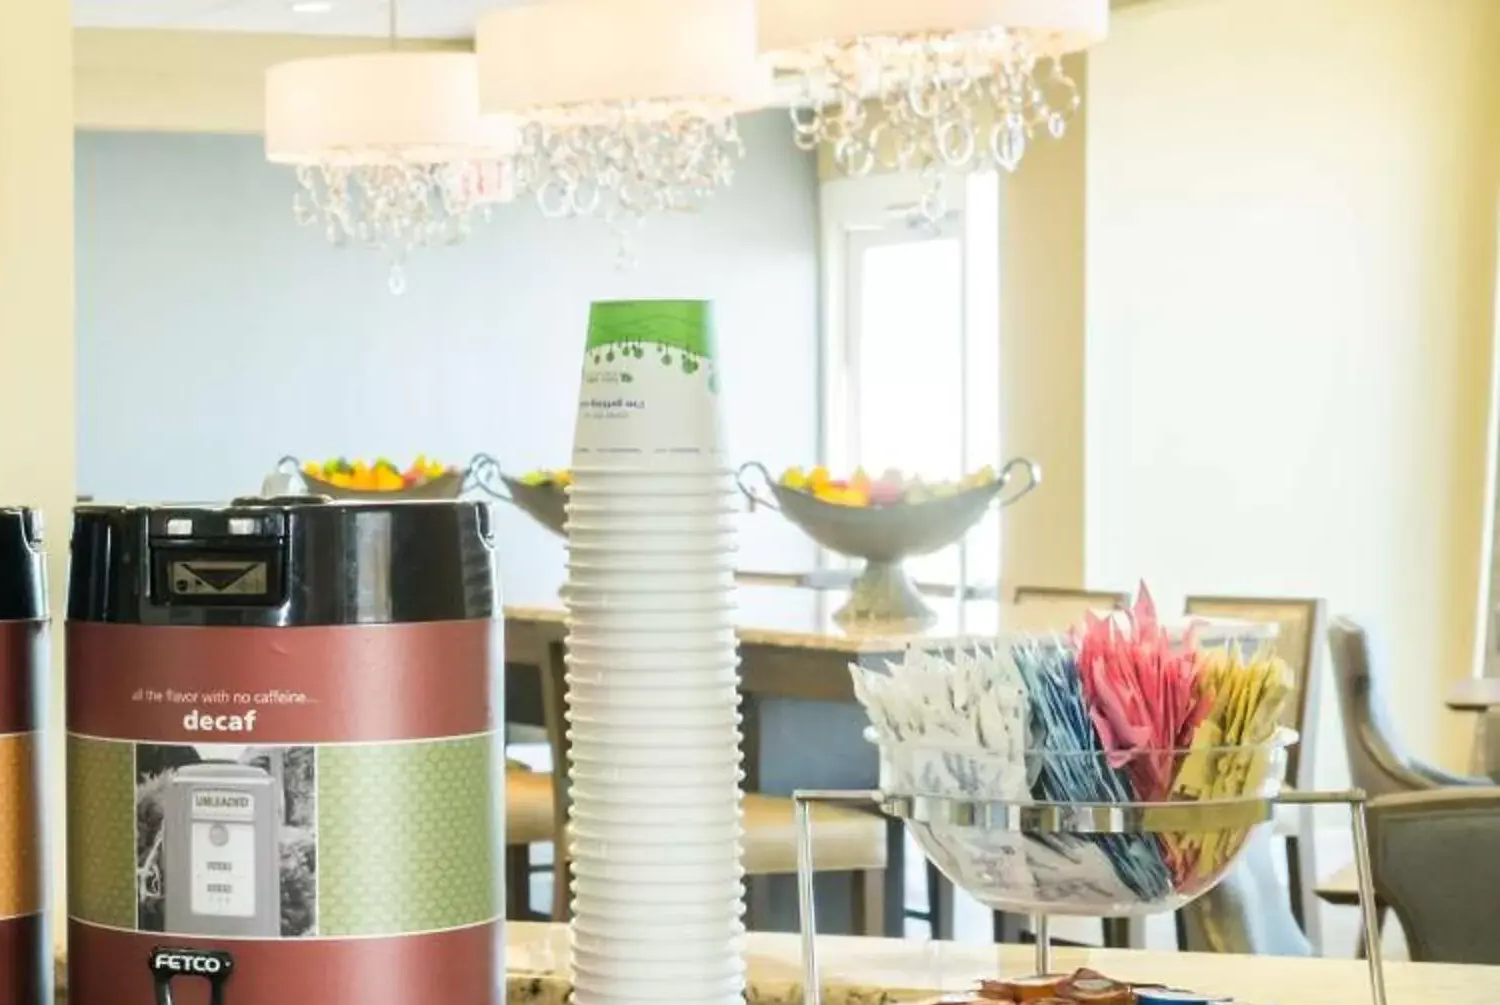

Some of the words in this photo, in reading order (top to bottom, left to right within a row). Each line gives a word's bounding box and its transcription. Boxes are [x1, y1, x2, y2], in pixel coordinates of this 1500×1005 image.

[201, 690, 230, 703] with
[233, 692, 250, 703] no
[183, 709, 257, 731] decaf
[155, 953, 221, 973] FETCO
